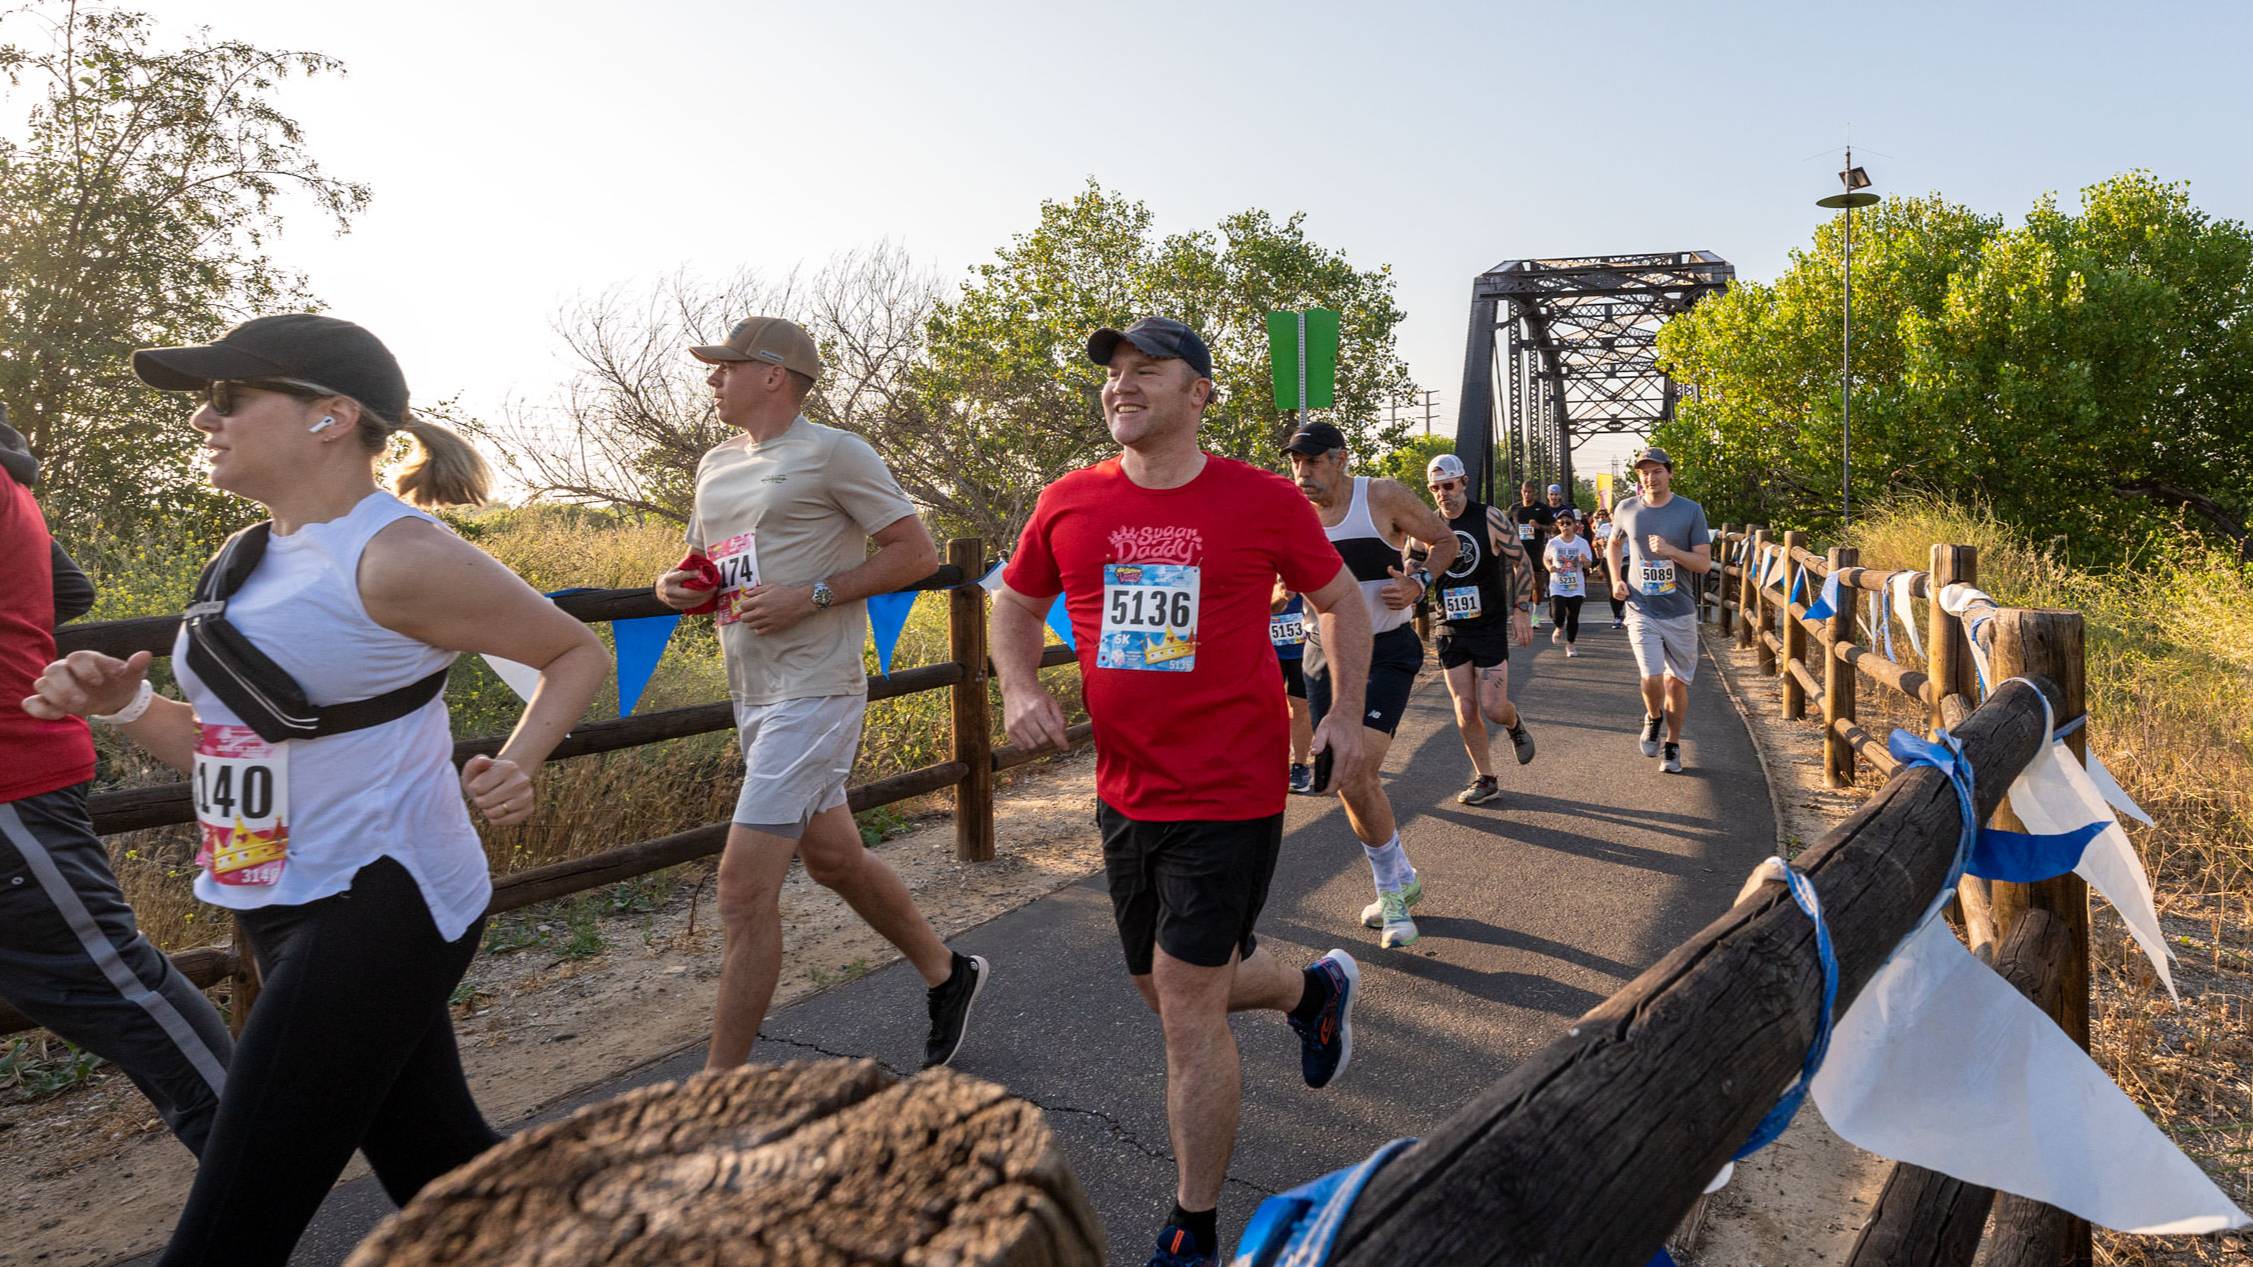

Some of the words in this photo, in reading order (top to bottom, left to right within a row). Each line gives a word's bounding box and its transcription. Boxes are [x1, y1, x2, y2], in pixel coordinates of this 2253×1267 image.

[1137, 526, 1198, 545] Sugar
[1115, 539, 1195, 565] Daddy
[720, 554, 753, 589] 174
[1643, 568, 1673, 581] 5089
[1111, 590, 1191, 628] 5136
[1447, 596, 1478, 612] 5191
[1271, 622, 1303, 639] 5153
[192, 762, 273, 819] 140
